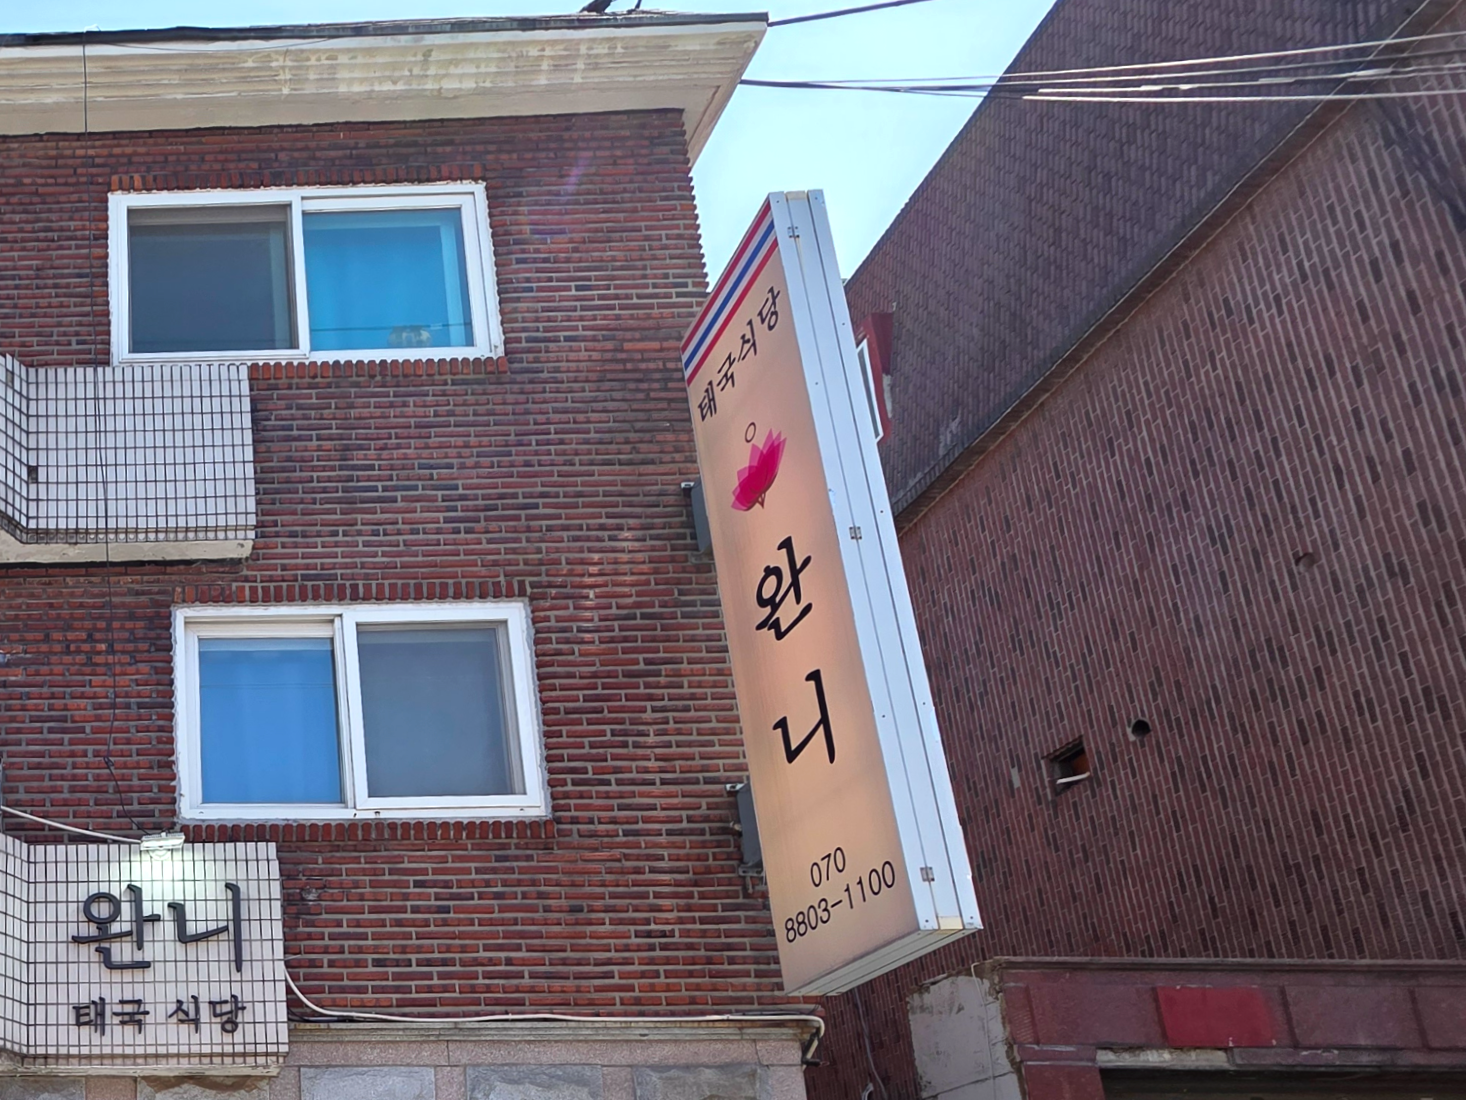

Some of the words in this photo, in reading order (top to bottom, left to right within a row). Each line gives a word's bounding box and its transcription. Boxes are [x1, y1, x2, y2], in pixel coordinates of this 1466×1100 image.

[783, 859, 897, 944] 8803-1100
[810, 846, 847, 889] 070
[71, 882, 241, 972] 완니
